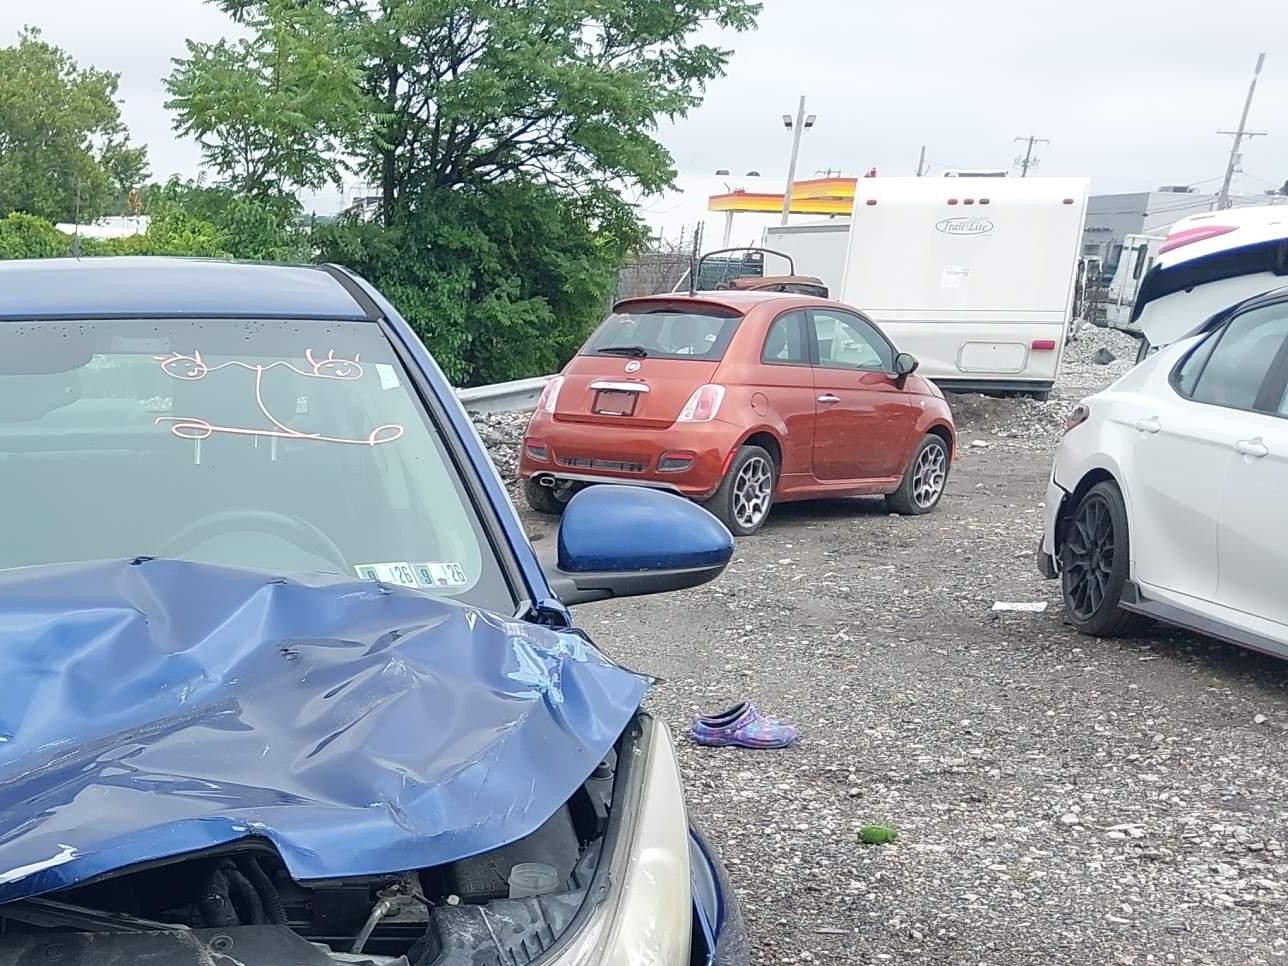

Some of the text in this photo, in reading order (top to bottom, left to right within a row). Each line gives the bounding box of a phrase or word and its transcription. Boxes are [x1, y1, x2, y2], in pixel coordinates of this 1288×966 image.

[394, 565, 413, 584] 26
[420, 564, 466, 585] 9 26
